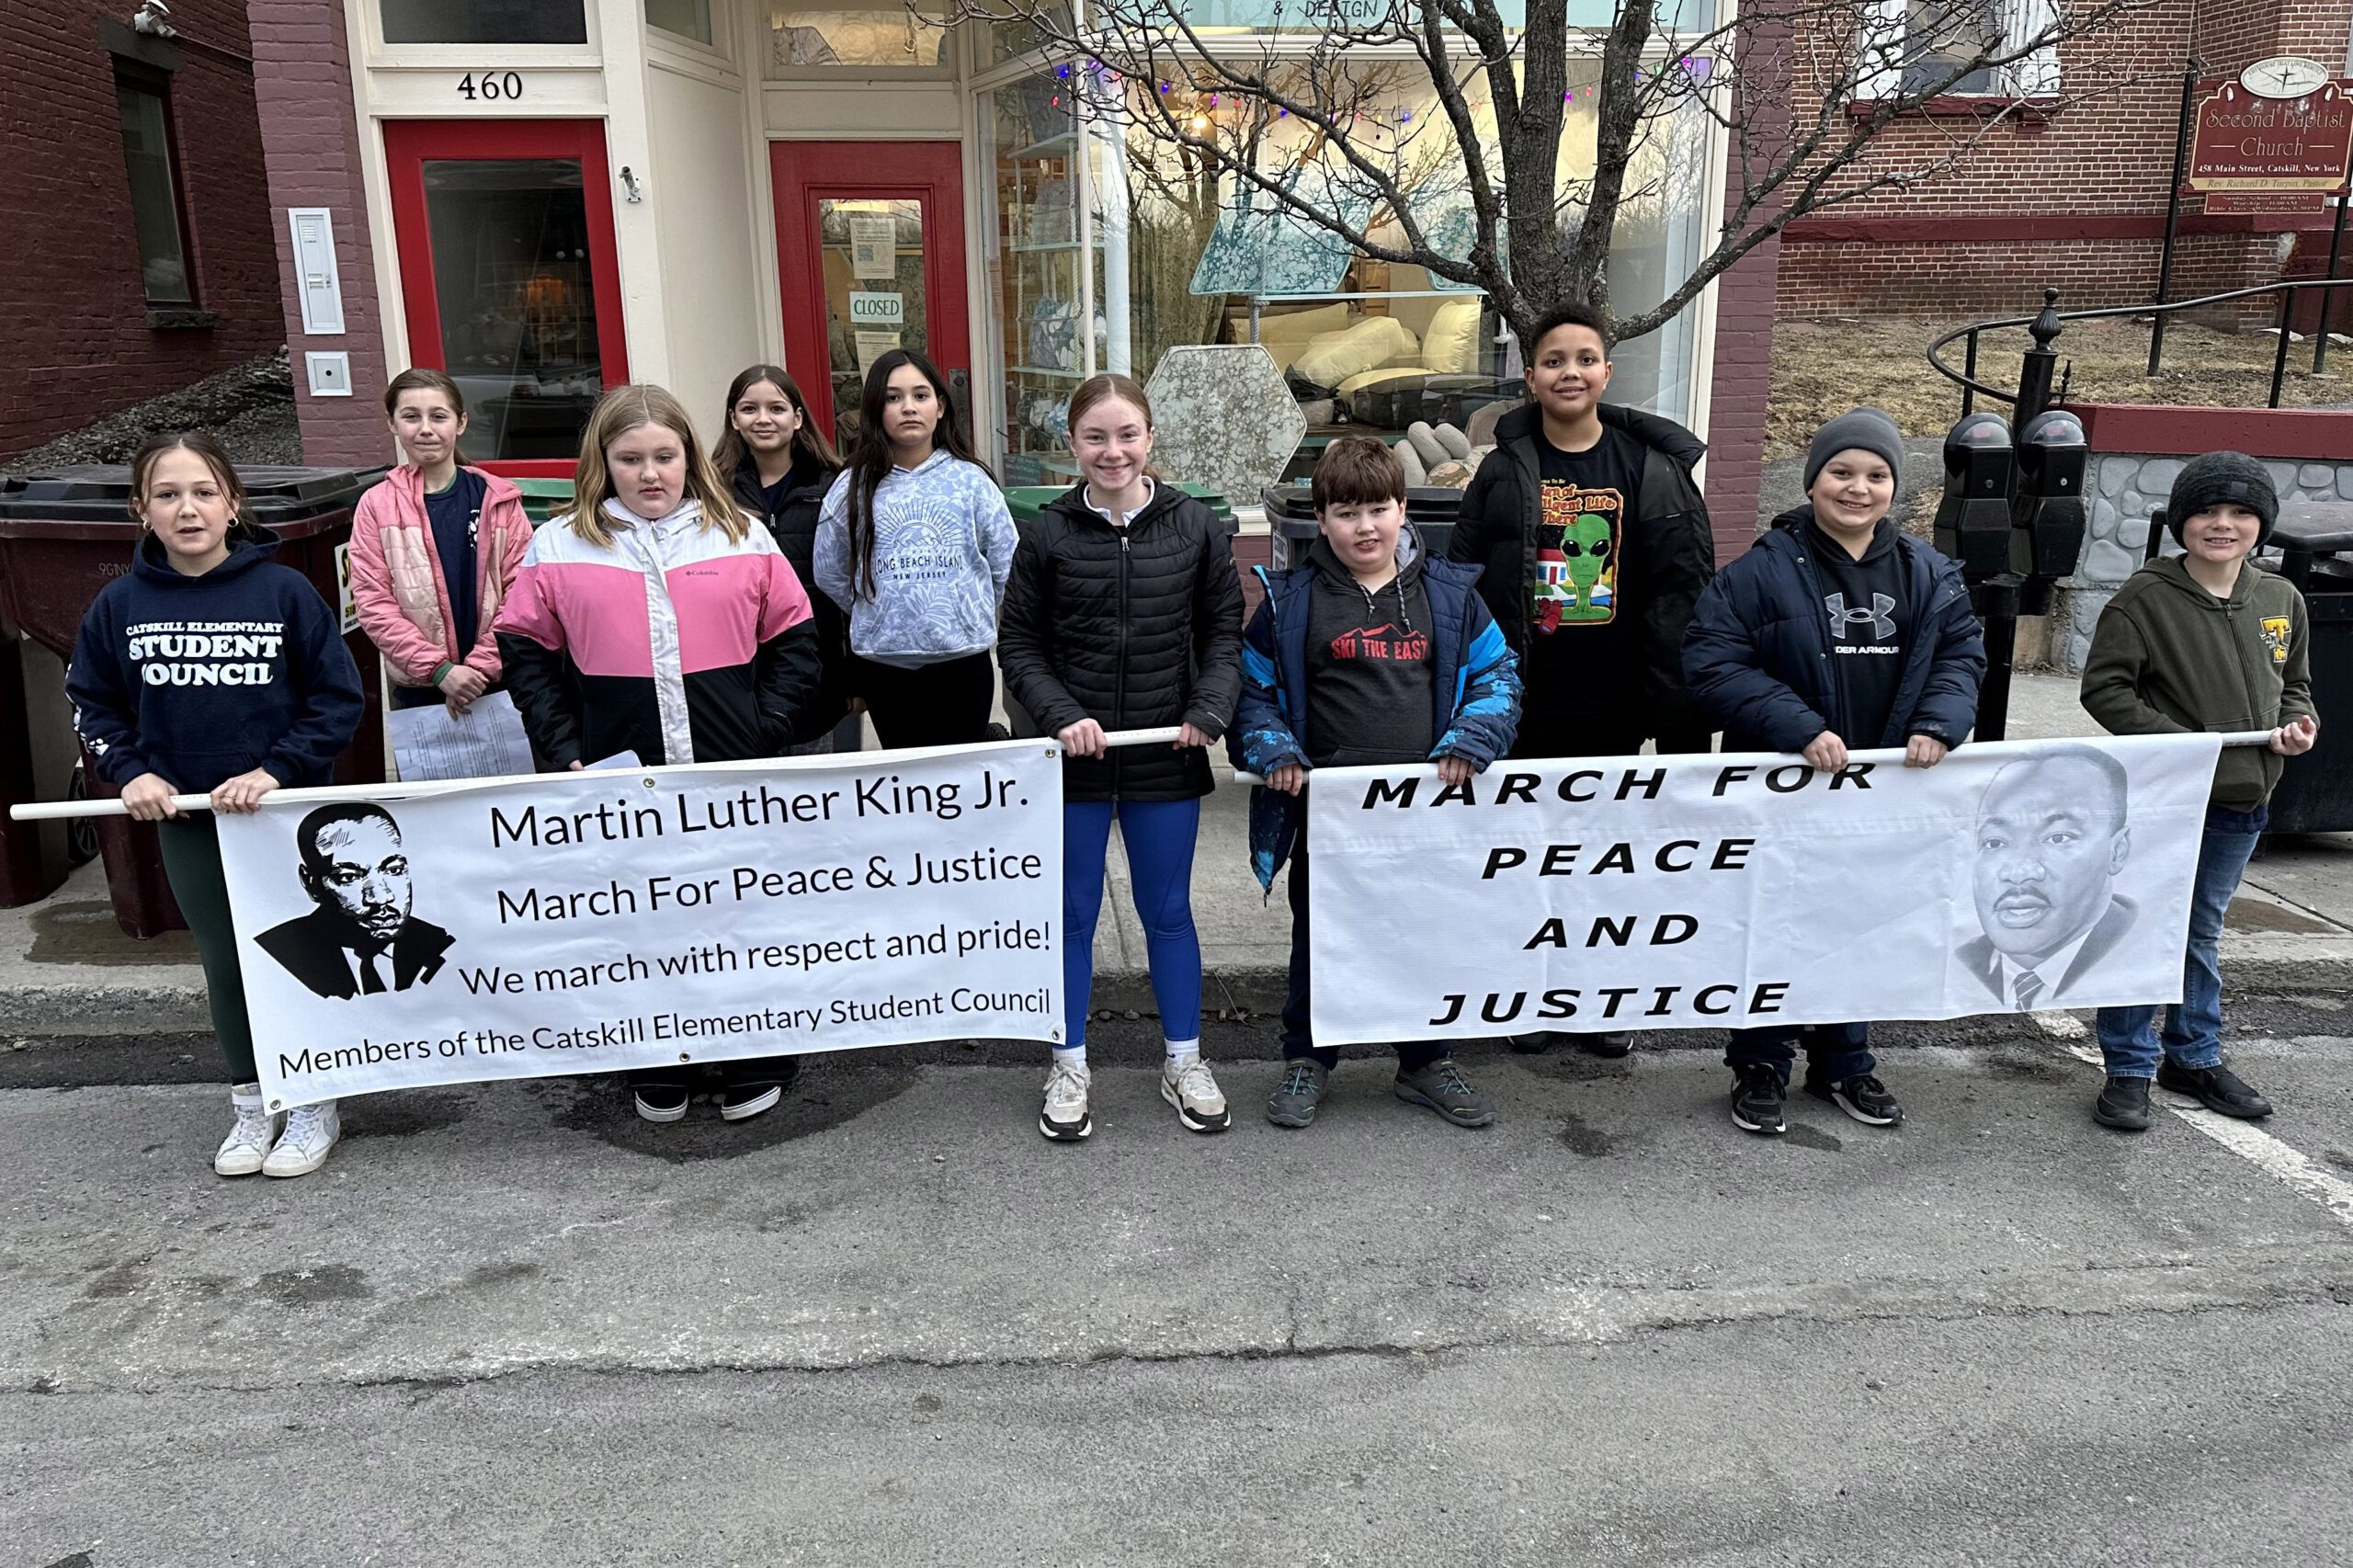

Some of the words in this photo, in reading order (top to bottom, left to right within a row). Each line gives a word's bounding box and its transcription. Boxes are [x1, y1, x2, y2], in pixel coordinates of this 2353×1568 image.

[1273, 1, 1283, 15] &
[1306, 0, 1378, 17] DEIGN
[457, 71, 523, 100] 460
[2206, 108, 2276, 129] Second
[2283, 108, 2346, 135] Baptist
[2241, 136, 2303, 157] Church
[2198, 165, 2212, 173] 458
[2215, 165, 2235, 173] Main
[2239, 165, 2265, 175] Street,
[2268, 164, 2301, 174] Catskill,
[2324, 164, 2340, 173] York
[2227, 178, 2258, 188] Richard
[2302, 178, 2328, 187] Pastor
[854, 299, 900, 316] CLOSED
[1585, 496, 1617, 511] Life
[901, 556, 930, 569] BEACH
[916, 571, 946, 579] JERSEY
[126, 622, 185, 636] CATSKILL
[187, 621, 284, 633] ELEMENTARY
[129, 634, 283, 661] STUDENT
[1331, 638, 1356, 660] SKI
[1362, 639, 1389, 658] THE
[1393, 640, 1427, 660] EAST
[1835, 645, 1857, 654] DER
[1858, 645, 1899, 654] ARMOUR
[142, 663, 274, 687] OUNCIL
[1362, 768, 1666, 810] MARCH
[1712, 762, 1876, 797] FOR
[491, 799, 664, 848] Martin
[678, 785, 840, 834] Luther
[856, 775, 962, 820] King
[974, 770, 1029, 810] Jr.
[1482, 839, 1756, 880] PEACE
[497, 880, 636, 924] March
[648, 876, 720, 911] For
[733, 866, 854, 902] Peace
[865, 855, 897, 889] &
[906, 846, 1042, 886] Justice
[1523, 914, 1699, 950] AND
[458, 966, 525, 995] We
[534, 953, 649, 992] march
[656, 943, 737, 977] with
[747, 932, 877, 971] respect
[886, 924, 947, 958] and
[958, 920, 1050, 958] pride!
[1429, 983, 1790, 1026] JUSTICE
[279, 1039, 431, 1079] Members
[438, 1030, 468, 1058] of
[475, 1028, 526, 1055] the
[532, 1017, 644, 1050] Catskill
[654, 1007, 823, 1040] Elementary
[830, 991, 944, 1024] Student
[950, 987, 1051, 1014] Council
